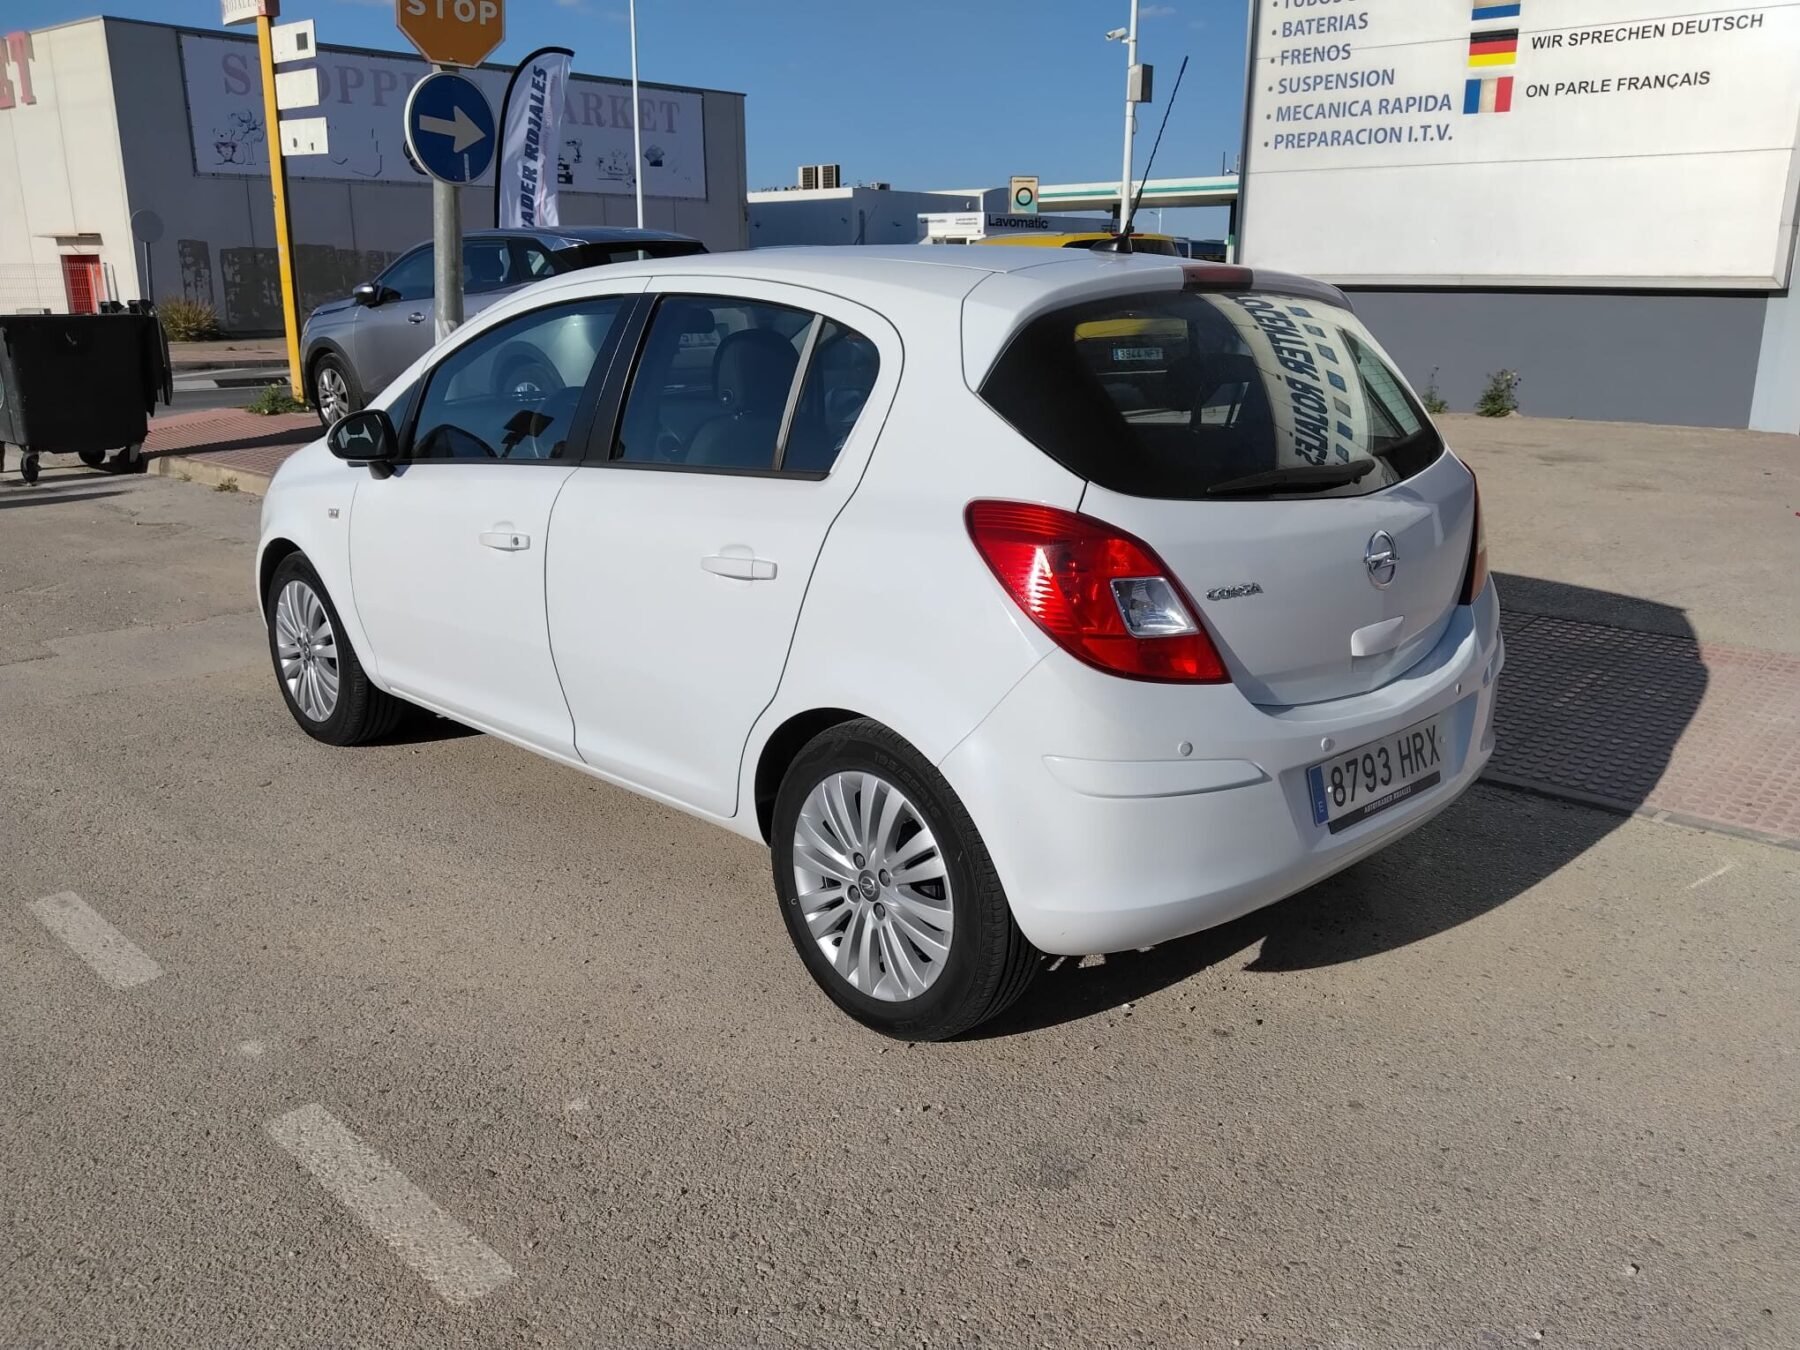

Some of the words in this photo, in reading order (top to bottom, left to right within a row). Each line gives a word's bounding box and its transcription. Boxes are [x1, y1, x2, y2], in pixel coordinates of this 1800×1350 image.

[406, 0, 497, 25] STOP
[1282, 12, 1368, 38] BATERIAS
[1532, 35, 1563, 50] WIR
[1568, 24, 1666, 46] SPRECHEN
[1671, 13, 1764, 36] DEUTSCH
[1280, 43, 1351, 66] FRENOS
[1278, 68, 1395, 94] SUSPENSION
[1526, 84, 1549, 98] ON
[1554, 79, 1611, 96] PARLE
[1616, 71, 1711, 91] FRANÇAIS
[524, 65, 547, 162] ROJALES
[562, 91, 680, 134] ARKET
[1276, 99, 1372, 122] MECANICA
[1378, 94, 1452, 115] RAPIDA
[1274, 126, 1402, 150] PREPARACION
[1408, 124, 1453, 143] I.T.V.
[520, 165, 538, 227] ADER
[988, 214, 1048, 229] Lavomatic
[1330, 747, 1392, 807] 8793
[1397, 725, 1441, 779] HRX
[1318, 801, 1325, 812] E
